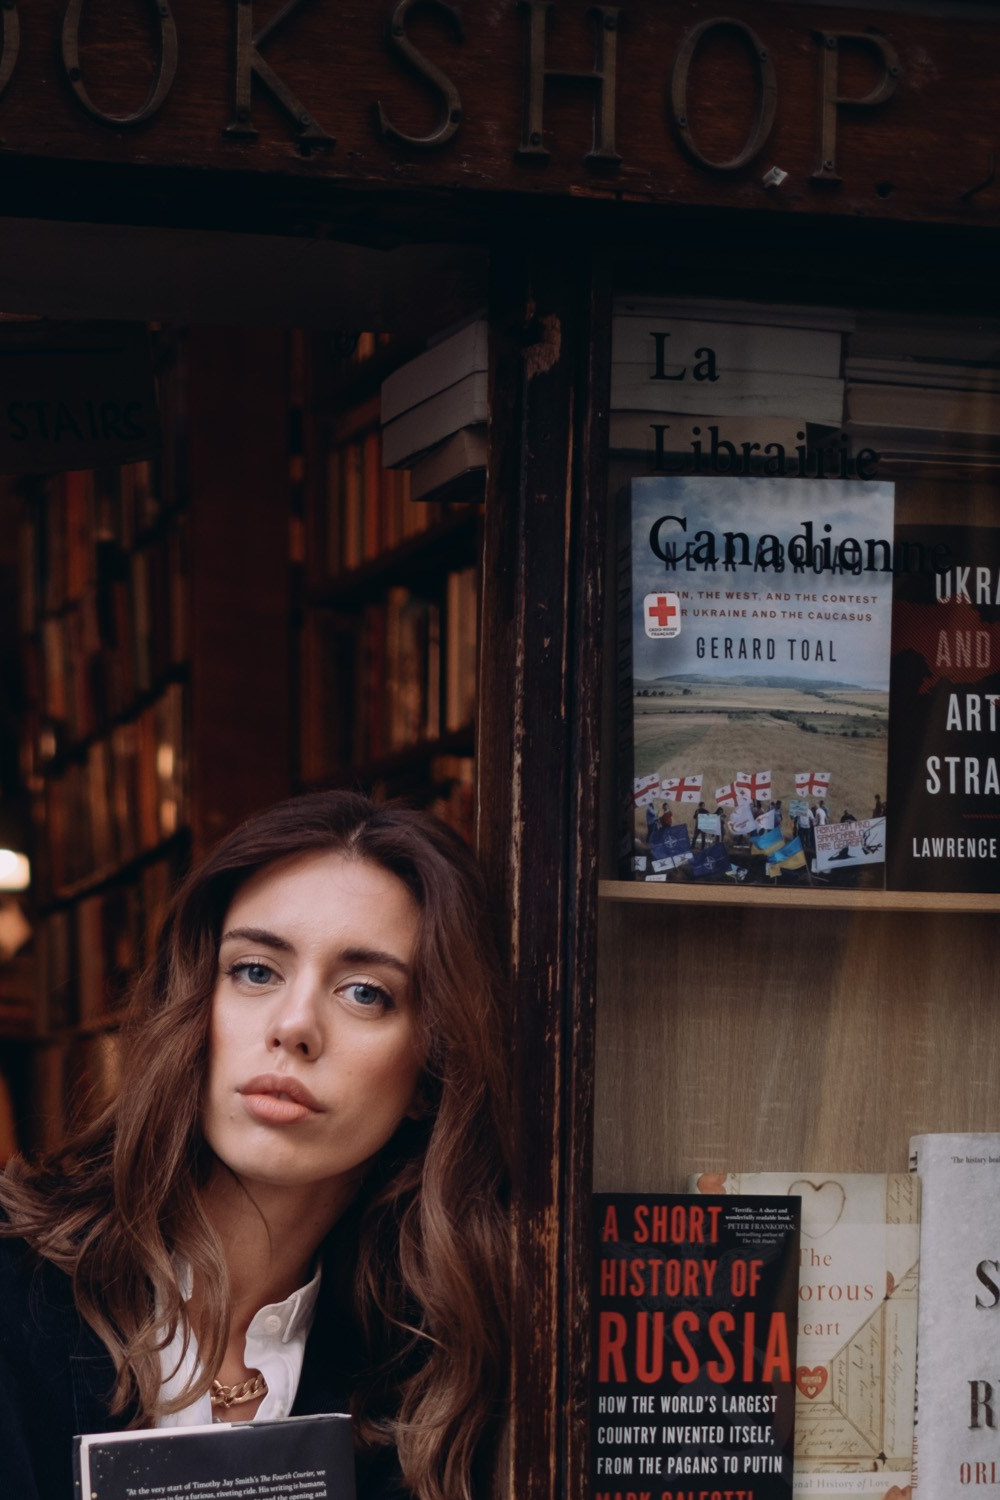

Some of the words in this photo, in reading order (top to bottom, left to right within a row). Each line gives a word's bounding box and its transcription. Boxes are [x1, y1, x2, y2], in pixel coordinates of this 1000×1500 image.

[649, 331, 721, 382] La
[649, 424, 881, 481] Librairie
[648, 514, 954, 576] Canadienne
[665, 542, 738, 572] NEAR
[753, 544, 863, 576] ABROAD
[697, 591, 721, 601] THE
[725, 591, 762, 603] WEST,
[766, 592, 792, 602] AND
[796, 593, 818, 603] THE
[821, 594, 878, 605] CONTEST
[693, 608, 747, 619] UKRAINE
[752, 610, 777, 620] AND
[780, 611, 803, 621] THE
[807, 612, 873, 623] CAUCASUS
[696, 636, 776, 661] GERARD
[787, 638, 837, 663] TOAL
[935, 631, 991, 668] AND
[912, 837, 997, 860] LAWRENCE
[602, 1204, 620, 1243] A
[633, 1204, 723, 1244] SHORT
[600, 1258, 718, 1298] HISTORY
[730, 1259, 764, 1298] OF
[598, 1310, 792, 1384] RUSSIA
[598, 1395, 627, 1414] HOW
[632, 1395, 655, 1414] THE
[660, 1394, 717, 1414] WORLD'S
[722, 1394, 778, 1414] LARGEST
[597, 1425, 657, 1444] COUNTRY
[662, 1425, 724, 1444] INVENTED
[729, 1426, 775, 1446] ITSELF,
[597, 1456, 633, 1475] FROM
[638, 1456, 662, 1475] THE
[667, 1456, 718, 1475] PAGANS
[723, 1455, 738, 1474] TO
[743, 1455, 783, 1474] PUTIN
[126, 1488, 137, 1496] "At
[137, 1486, 150, 1495] the
[150, 1486, 166, 1494] very
[166, 1484, 183, 1492] start
[183, 1482, 191, 1490] of
[191, 1479, 221, 1489] Timothy
[221, 1478, 233, 1487] Jay
[234, 1475, 259, 1485] Smith's
[259, 1474, 271, 1482] The
[271, 1472, 292, 1481] Fourth
[292, 1470, 315, 1479] Courier,
[189, 1492, 216, 1500] furious,
[216, 1489, 243, 1498] riveting
[242, 1486, 257, 1495] ride.
[258, 1485, 270, 1493] His
[269, 1484, 293, 1492] writing
[292, 1482, 299, 1490] is
[298, 1480, 326, 1488] humane,
